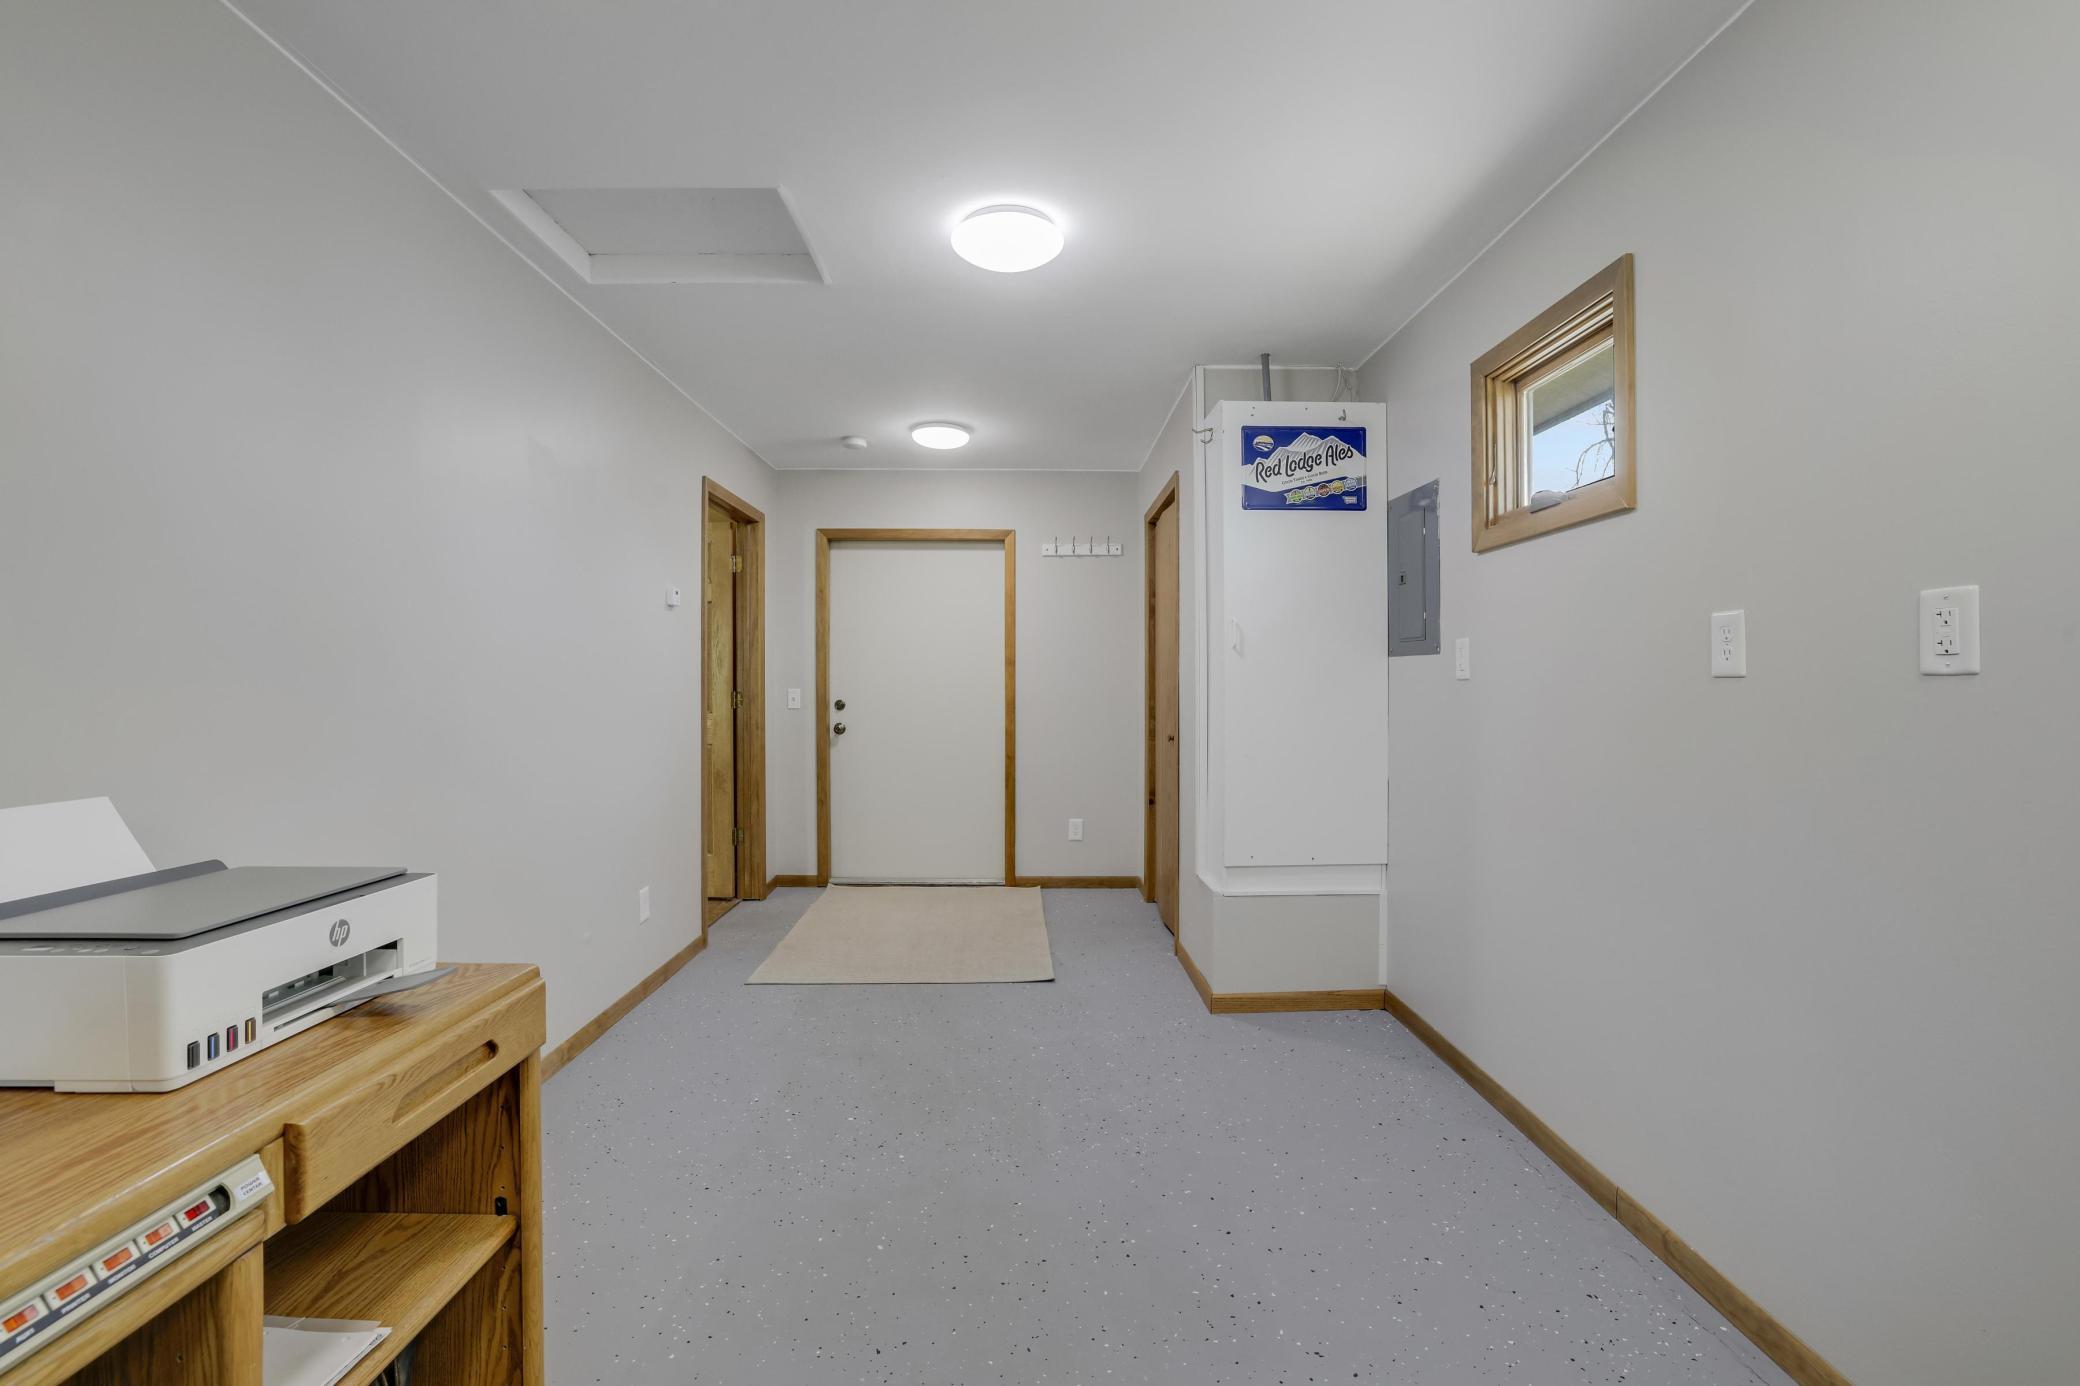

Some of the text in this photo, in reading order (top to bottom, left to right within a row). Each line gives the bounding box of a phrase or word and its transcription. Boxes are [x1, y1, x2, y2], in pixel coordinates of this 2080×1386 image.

[1255, 458, 1282, 483] Red
[1285, 451, 1322, 477] Lodge
[1325, 444, 1354, 467] Ales
[331, 919, 349, 948] hp
[148, 1237, 180, 1259] COMPUTER
